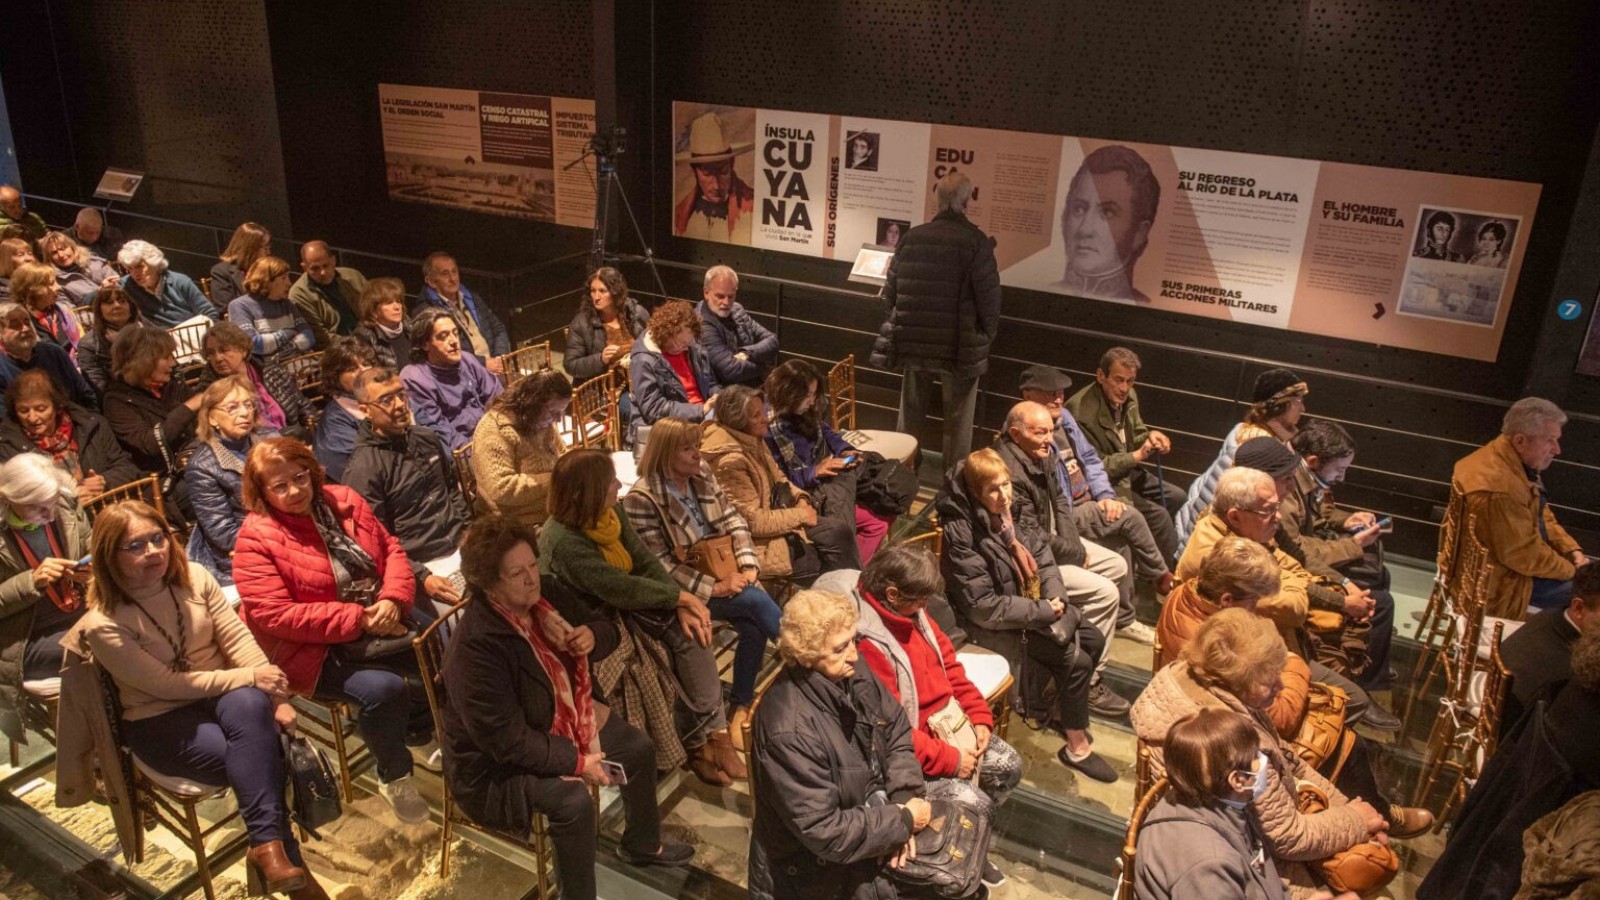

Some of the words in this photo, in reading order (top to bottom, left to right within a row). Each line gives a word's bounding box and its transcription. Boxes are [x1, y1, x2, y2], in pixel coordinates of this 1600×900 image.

[392, 98, 433, 108] LEGISLACIÓN
[449, 102, 476, 112] MARTÍN
[398, 108, 420, 116] ORDEN
[420, 110, 445, 118] SOCIAL
[481, 105, 506, 114] CENSO
[506, 107, 550, 118] CATASTRAL
[488, 114, 510, 124] RIEGO
[556, 112, 596, 122] IMPUESTO
[556, 120, 588, 130] SISTEMA
[764, 123, 815, 142] ÍNSULA
[763, 140, 812, 170] CU
[936, 148, 974, 165] EDU
[763, 168, 810, 200] YA
[828, 156, 840, 220] ORÍGENES
[1178, 171, 1196, 180] SU
[1198, 173, 1256, 188] REGRESO
[1178, 181, 1193, 192] AL
[1196, 182, 1216, 194] RÍO
[1220, 187, 1236, 196] DE
[1239, 188, 1256, 198] LA
[1258, 190, 1298, 203] PLATA
[762, 198, 813, 231] NA
[1324, 200, 1338, 210] EL
[1342, 202, 1397, 218] HOMBRE
[1322, 210, 1330, 218] Y
[1332, 211, 1350, 221] SU
[1352, 214, 1404, 228] FAMILIA
[827, 223, 836, 248] SUS
[1161, 280, 1183, 290] SUS
[1186, 282, 1242, 299] PRIMERAS
[1160, 290, 1216, 305] ACCIONES
[1218, 296, 1278, 314] MILITARES
[1565, 303, 1576, 316] 7
